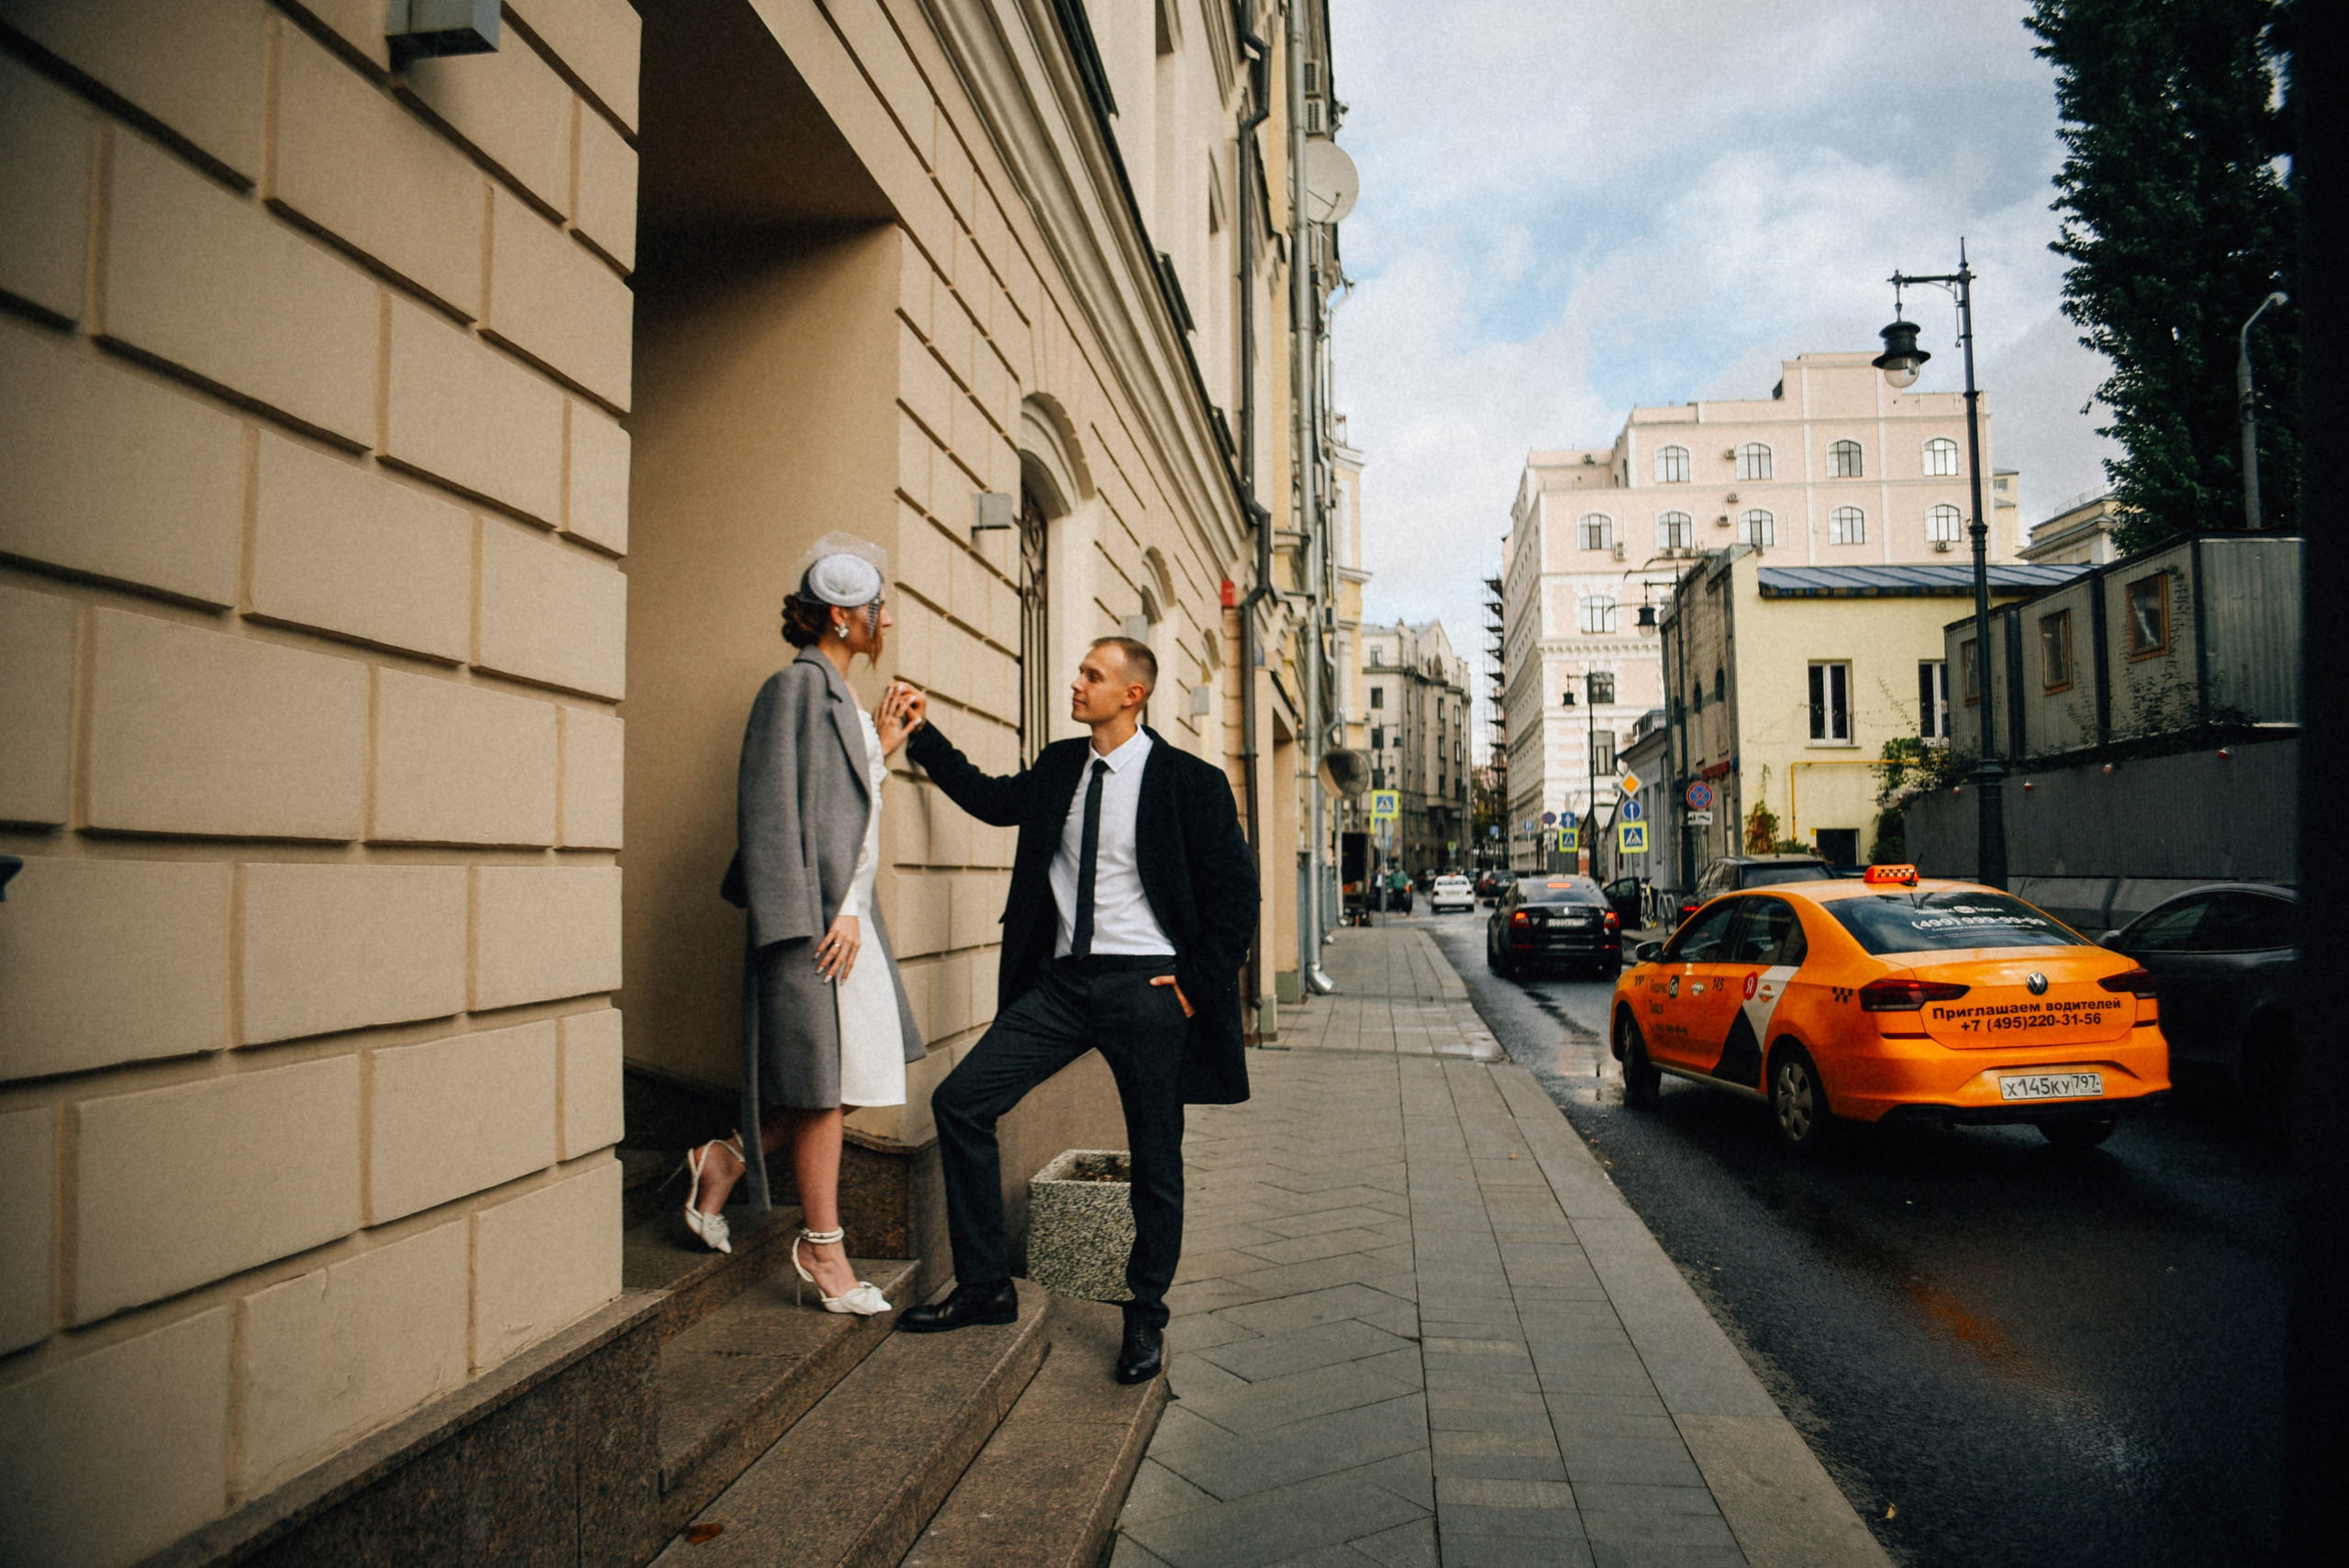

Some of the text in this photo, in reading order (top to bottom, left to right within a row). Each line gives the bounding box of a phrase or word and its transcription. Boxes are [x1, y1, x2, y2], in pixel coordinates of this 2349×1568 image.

[1712, 977, 1724, 991] 145
[1932, 997, 2121, 1021] Приглашаем водителей
[1961, 1013, 2101, 1032] +7 (495)220-31-56
